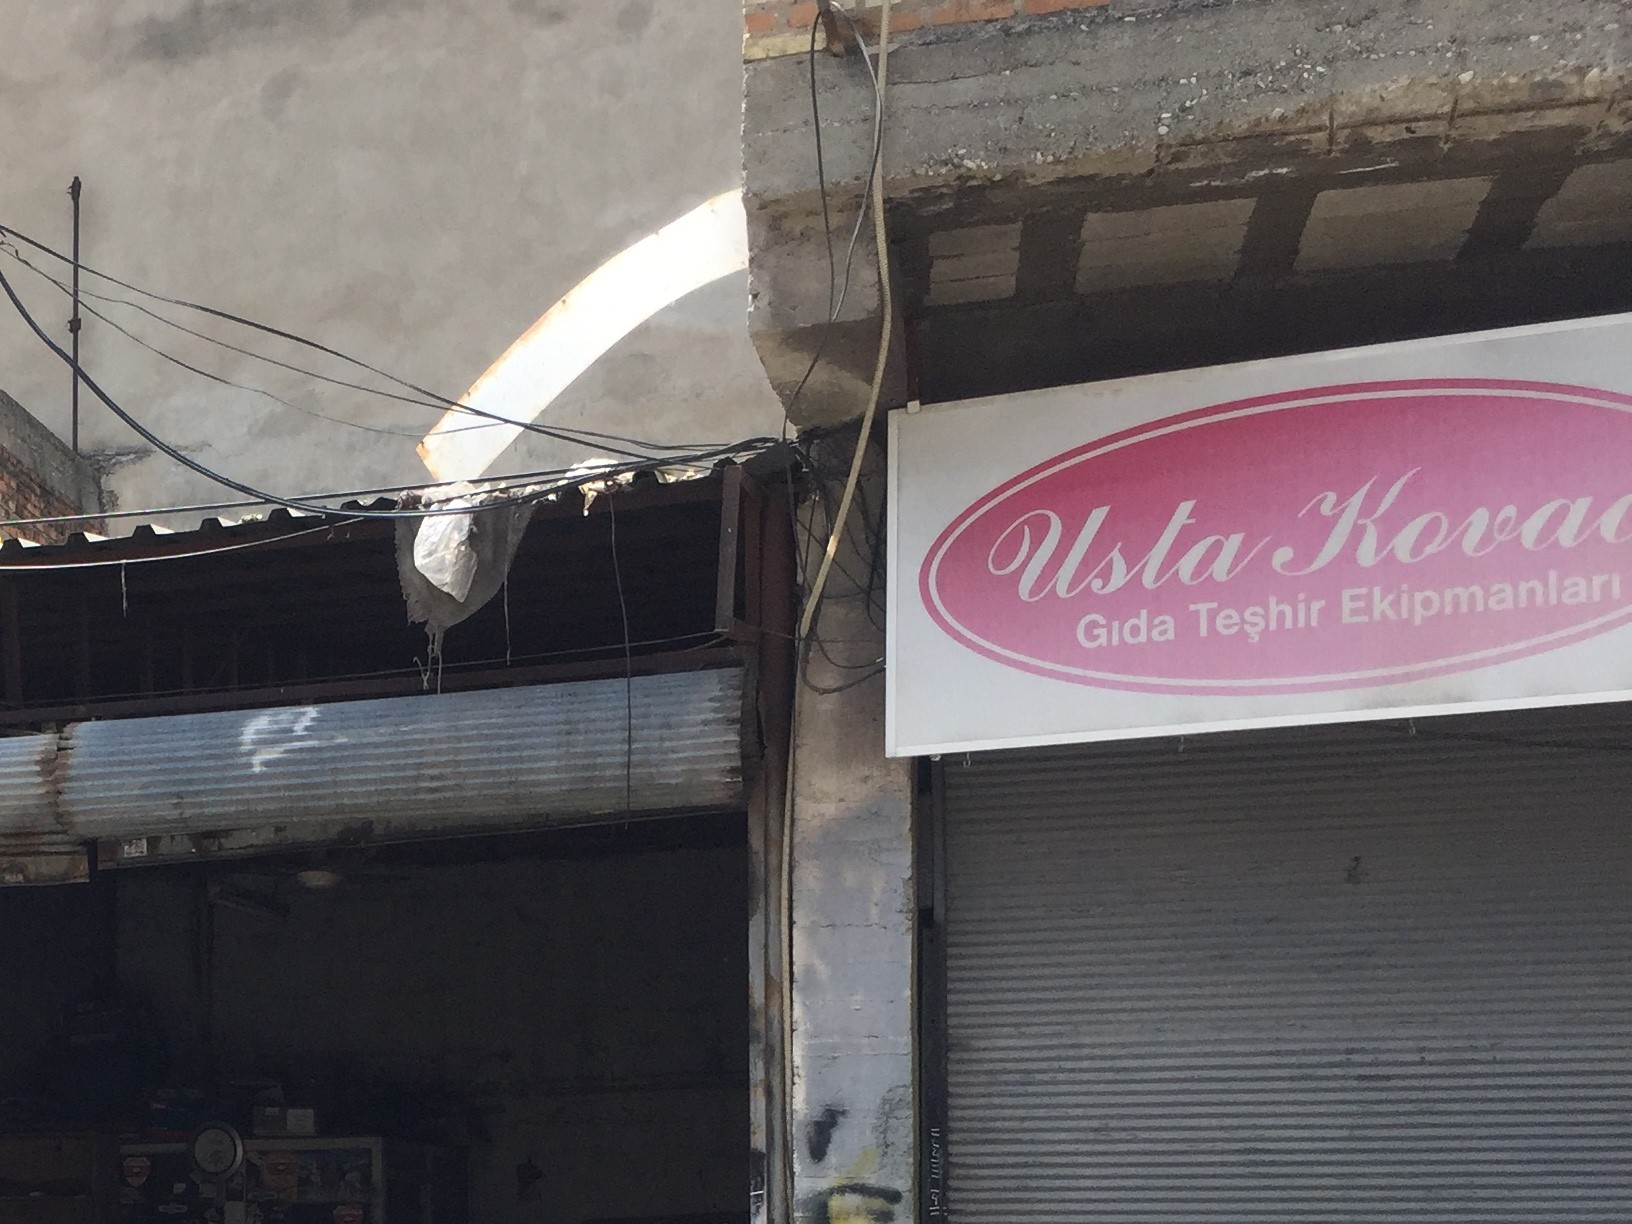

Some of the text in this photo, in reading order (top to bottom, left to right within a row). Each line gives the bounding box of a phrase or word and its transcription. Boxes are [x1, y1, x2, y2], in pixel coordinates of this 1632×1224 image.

[988, 500, 1272, 602] Usta
[1076, 569, 1623, 649] Gıda Teşhir Ekipmanları
